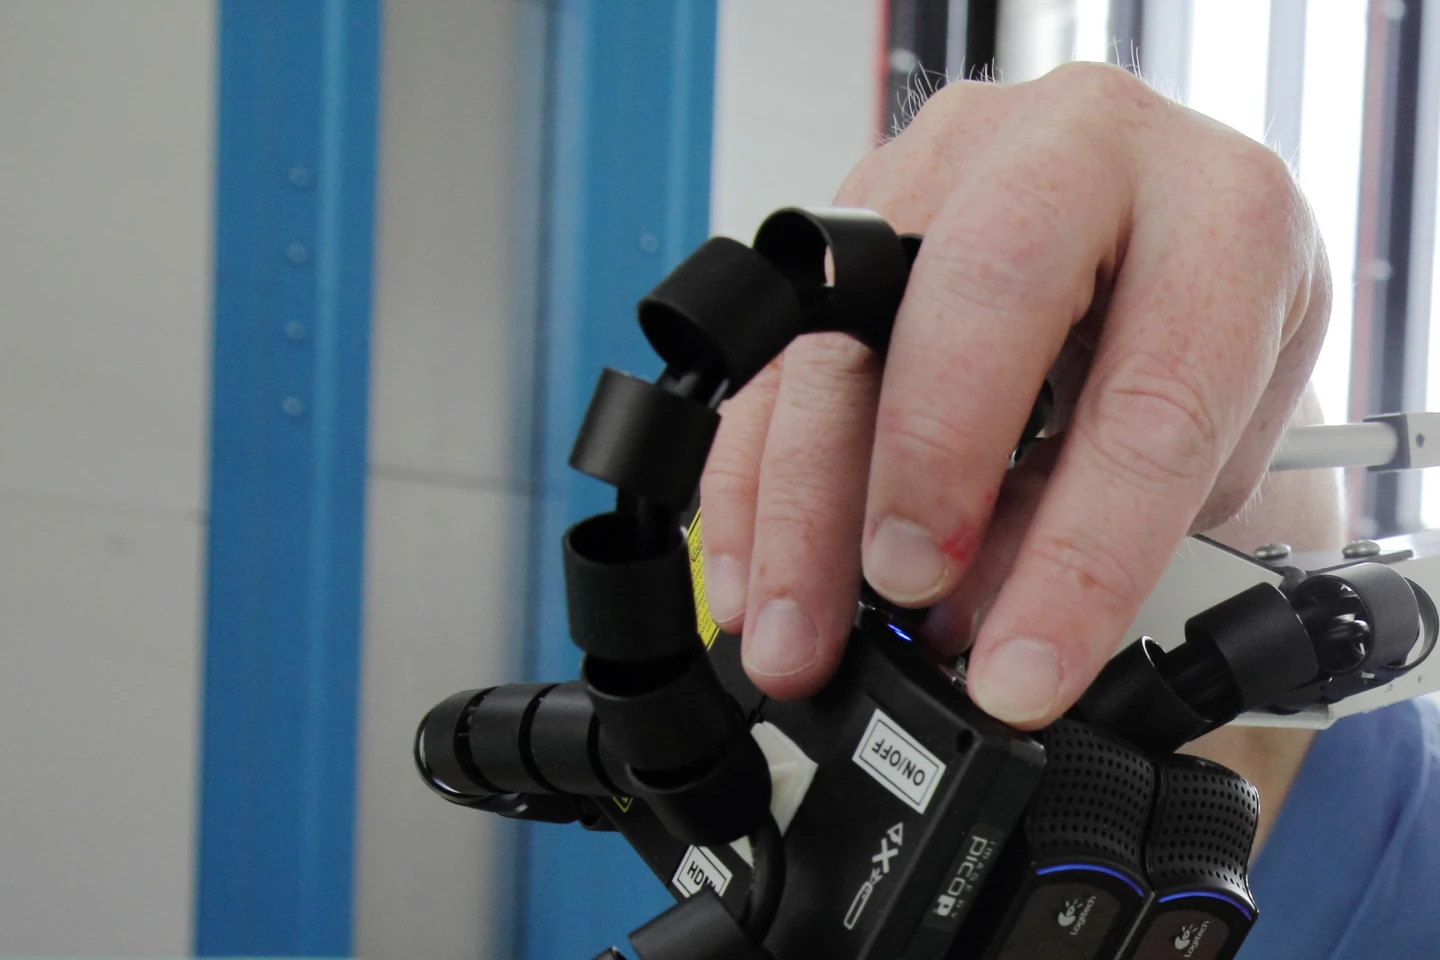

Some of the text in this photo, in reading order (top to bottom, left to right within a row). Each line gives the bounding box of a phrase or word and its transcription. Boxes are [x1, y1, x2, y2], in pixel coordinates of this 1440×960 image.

[871, 738, 926, 787] ON/OFF
[1069, 895, 1097, 936] Logitech
[1183, 920, 1210, 958] Logitech
